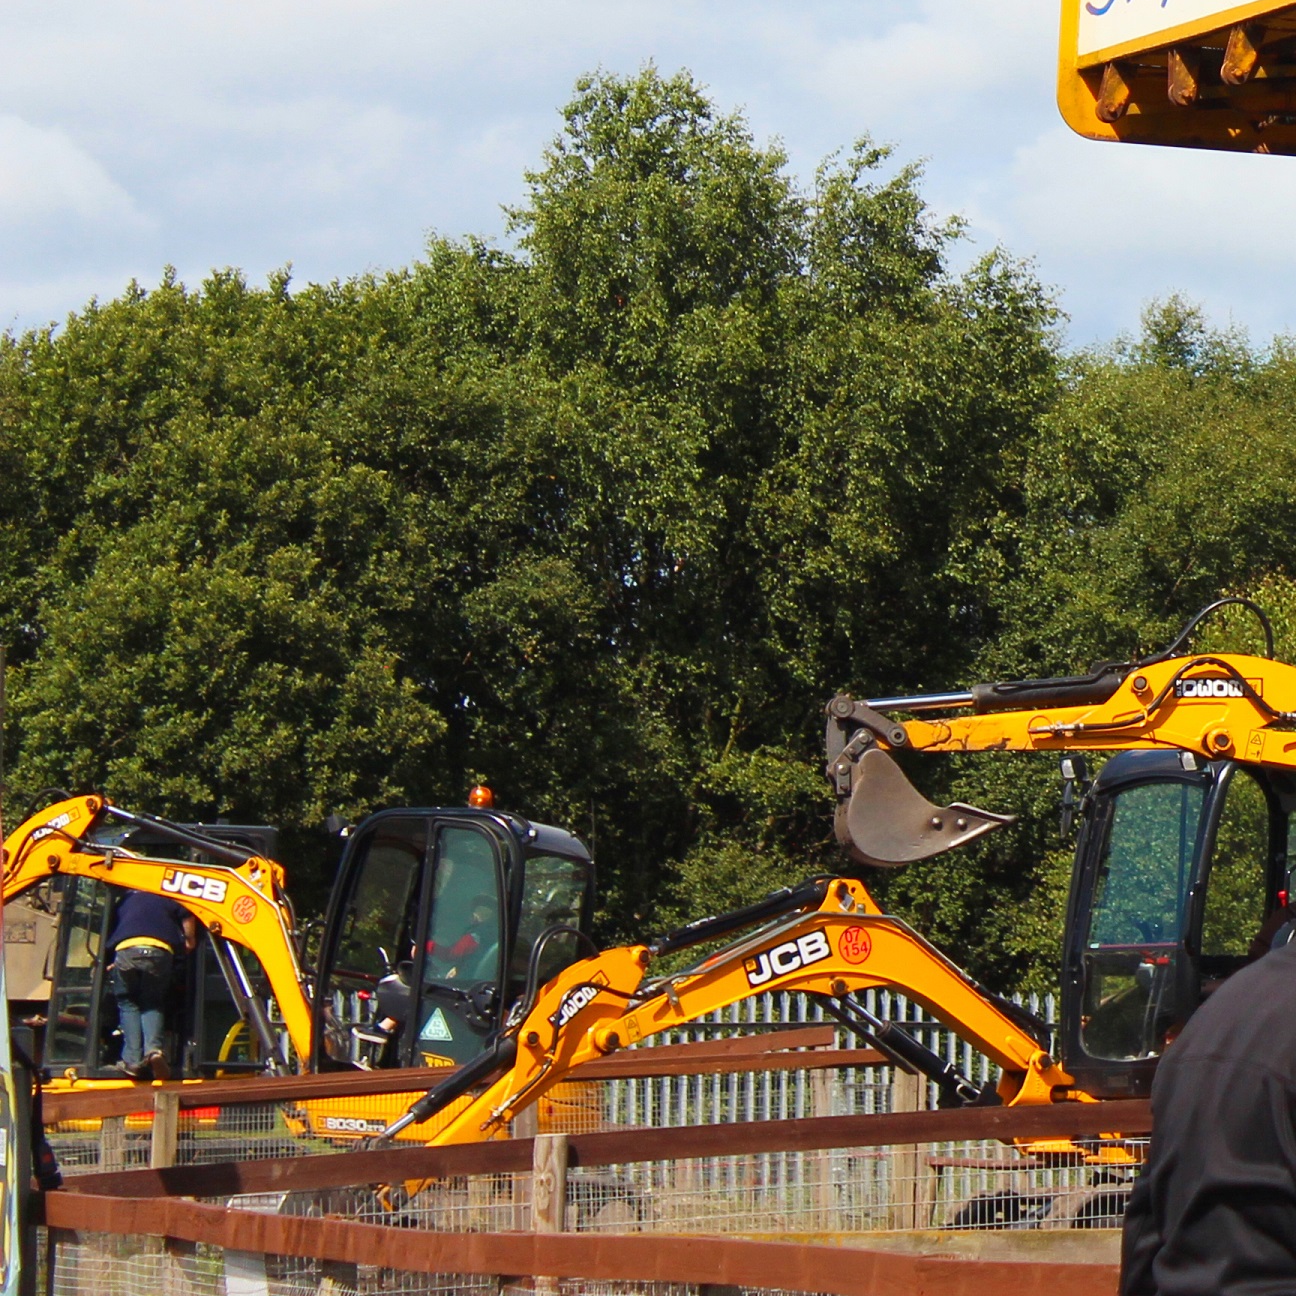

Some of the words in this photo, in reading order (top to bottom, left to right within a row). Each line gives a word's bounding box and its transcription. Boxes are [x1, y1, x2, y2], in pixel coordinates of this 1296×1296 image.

[162, 871, 229, 904] JCB
[844, 928, 860, 944] 07
[748, 930, 831, 985] JCB
[843, 941, 869, 958] 154
[326, 1116, 367, 1132] 8030
